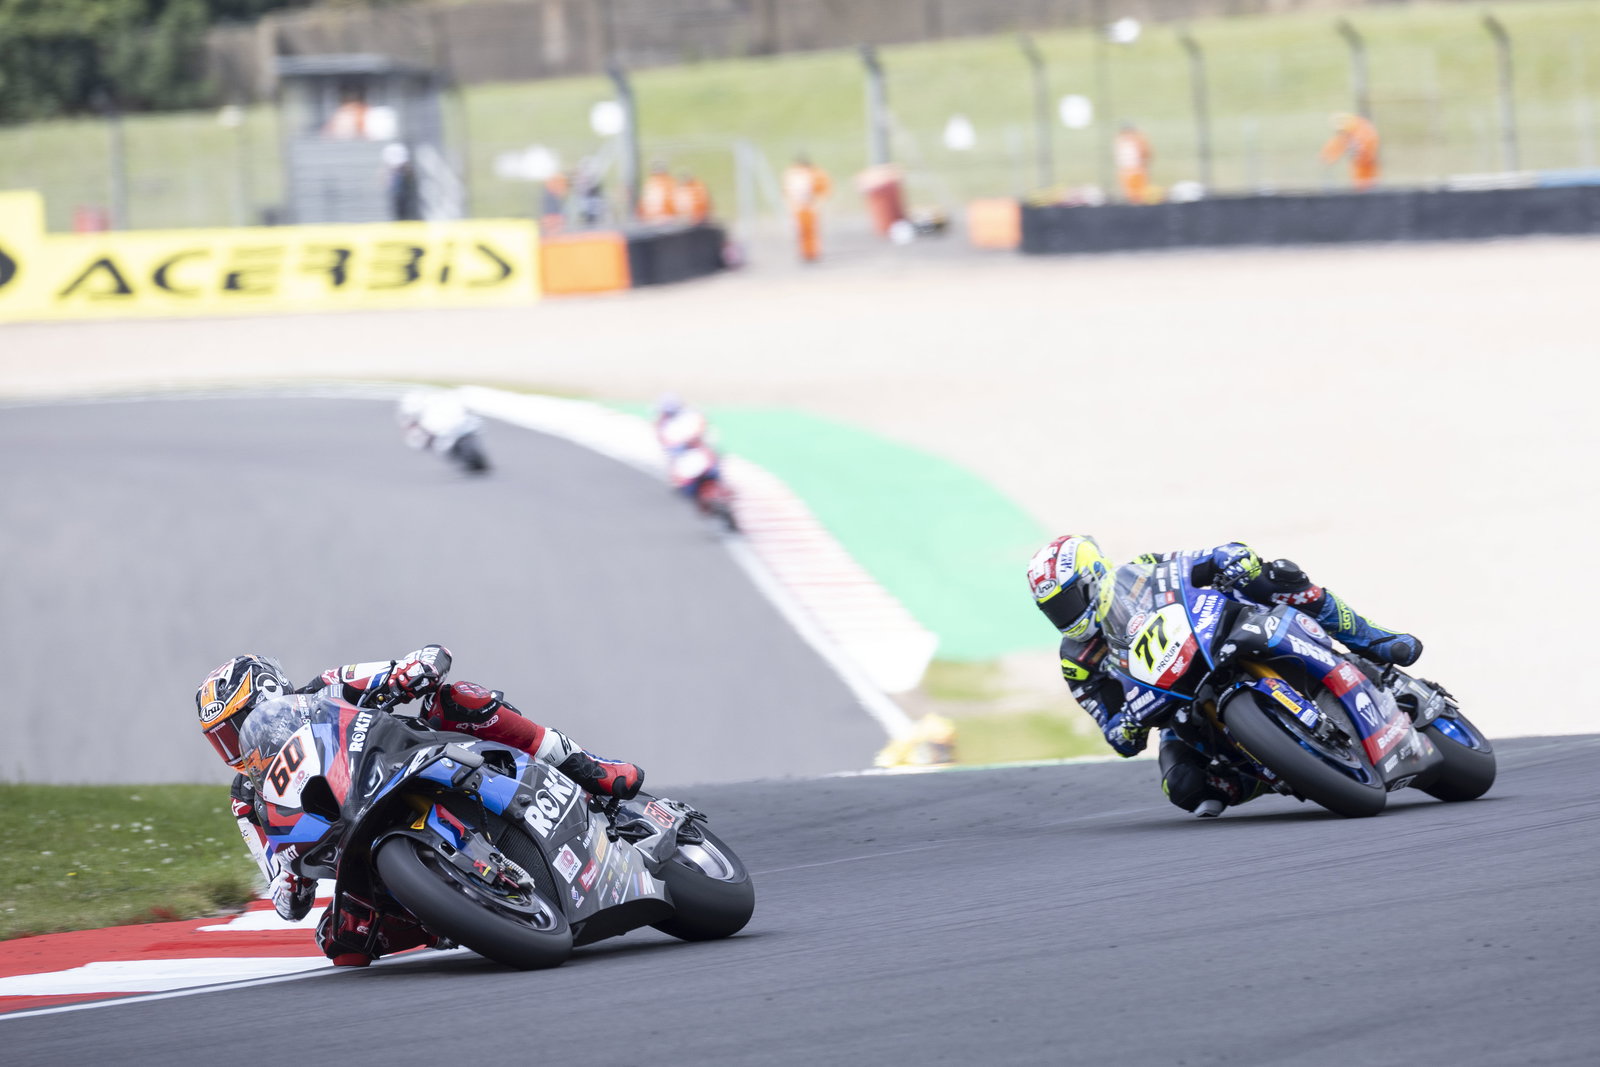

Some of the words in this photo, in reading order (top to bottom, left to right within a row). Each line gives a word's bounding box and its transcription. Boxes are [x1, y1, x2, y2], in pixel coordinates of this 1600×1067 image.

[1134, 614, 1168, 673] 77
[202, 704, 221, 719] Arai
[267, 735, 306, 798] 60
